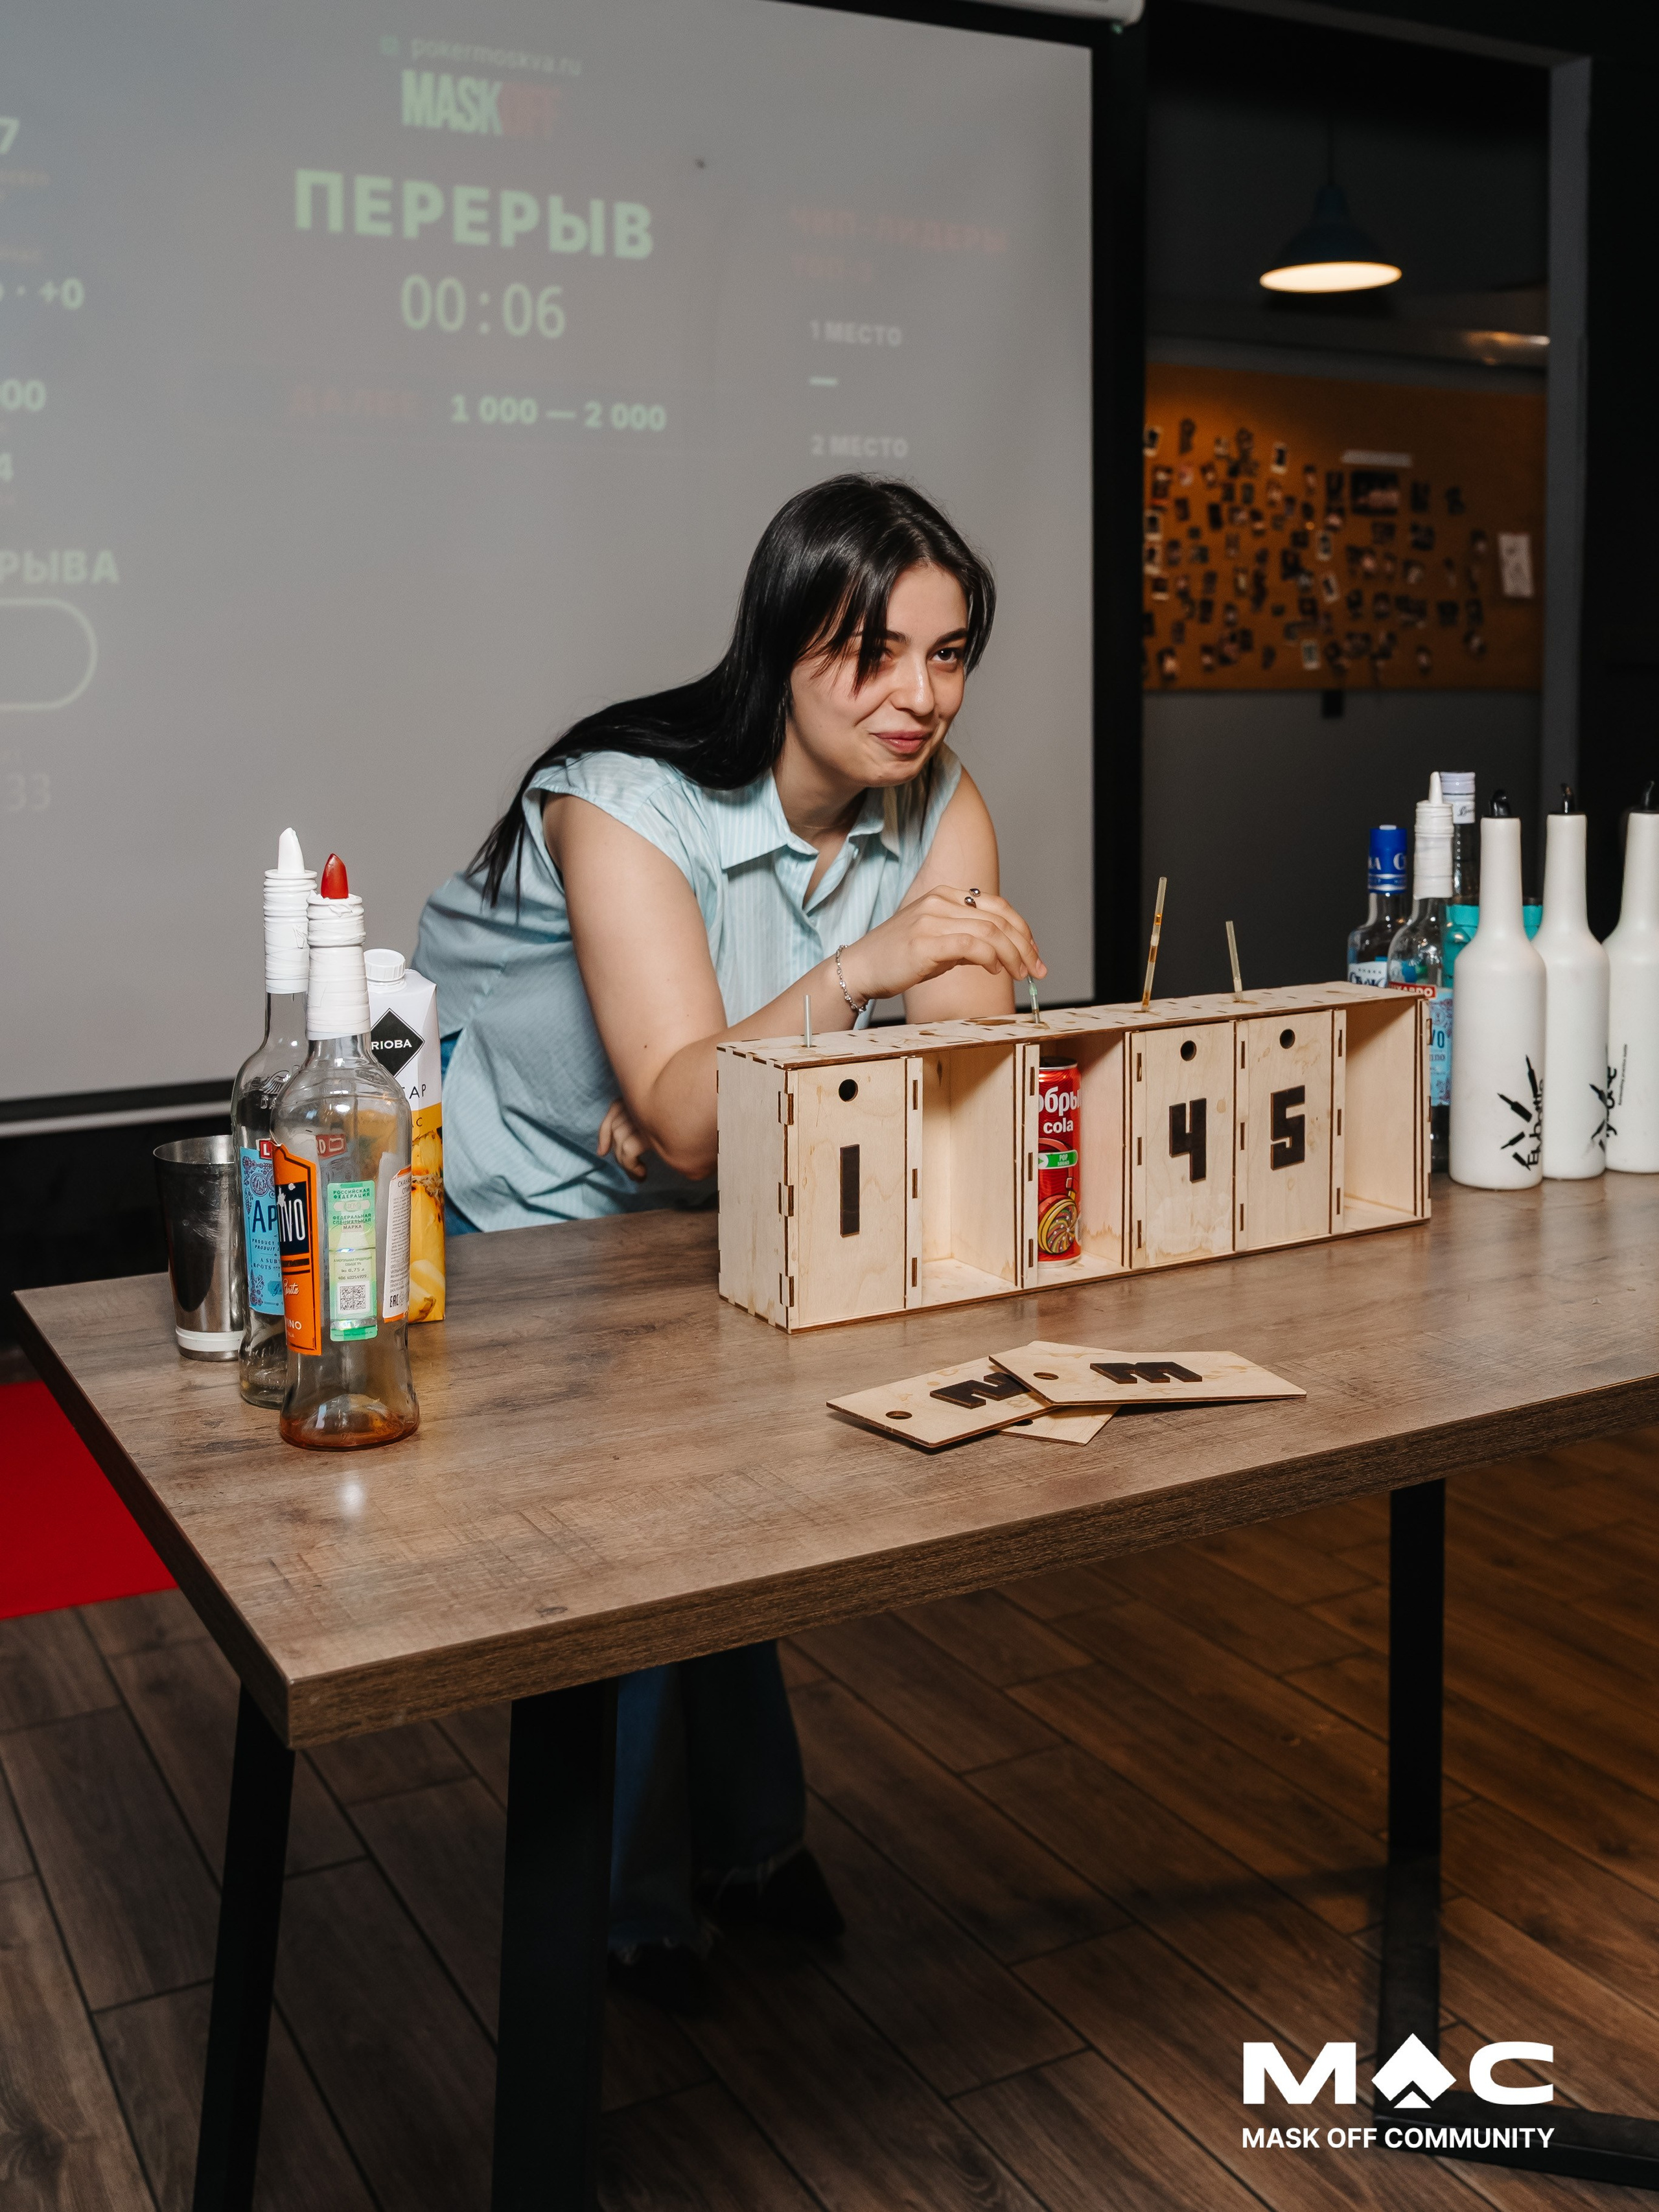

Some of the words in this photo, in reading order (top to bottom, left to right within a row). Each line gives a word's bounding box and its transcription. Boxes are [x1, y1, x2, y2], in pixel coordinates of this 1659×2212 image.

[410, 38, 582, 76] pokermoskva.ru
[295, 168, 654, 259] ПЕРЕРЫВ
[400, 274, 566, 339] 00:06
[824, 321, 903, 347] МЕСТО
[450, 395, 469, 423] 1
[478, 396, 538, 424] 000
[585, 401, 603, 428] 2
[611, 404, 666, 432] 000
[810, 434, 826, 456] 2
[830, 435, 909, 459] МЕСТО
[371, 1039, 412, 1051] RIOBA
[1043, 1117, 1074, 1134] cola
[1168, 1098, 1207, 1182] 4
[1270, 1085, 1306, 1171] 5
